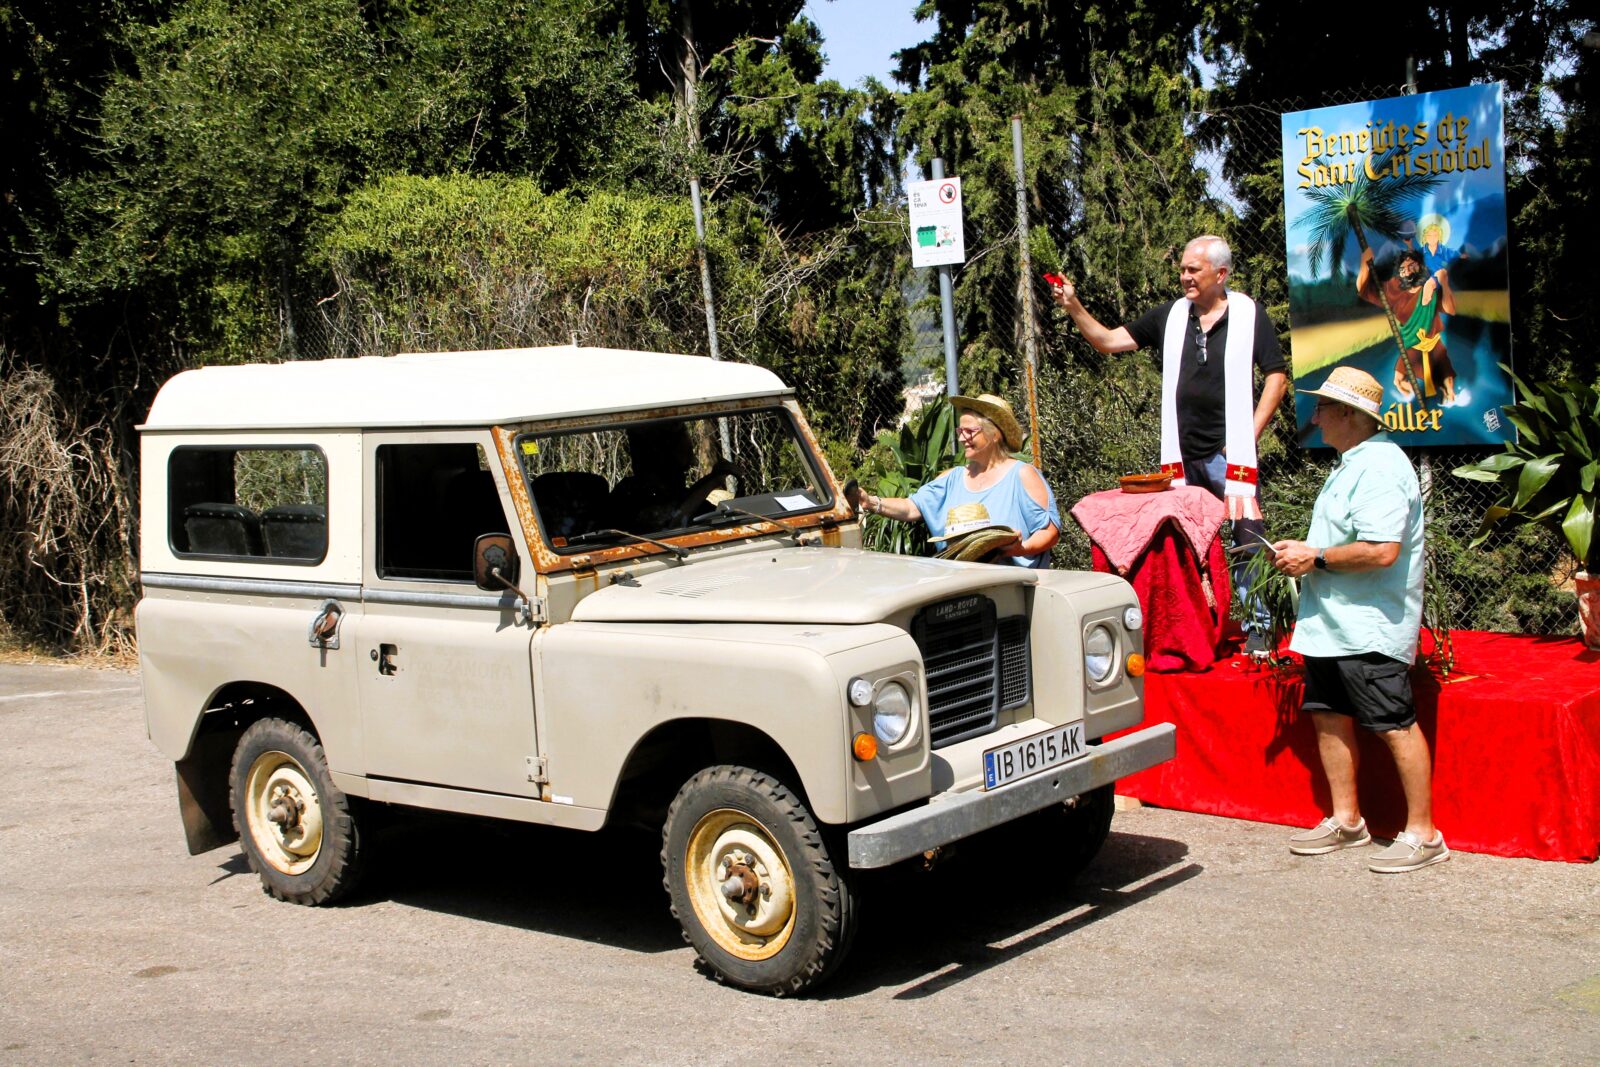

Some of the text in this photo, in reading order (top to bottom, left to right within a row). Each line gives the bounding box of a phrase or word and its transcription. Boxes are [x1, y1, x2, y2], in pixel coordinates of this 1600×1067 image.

[1437, 112, 1470, 142] de
[1296, 157, 1356, 190] Sant
[1377, 402, 1443, 432] óller
[997, 726, 1080, 781] IB 1615 AK
